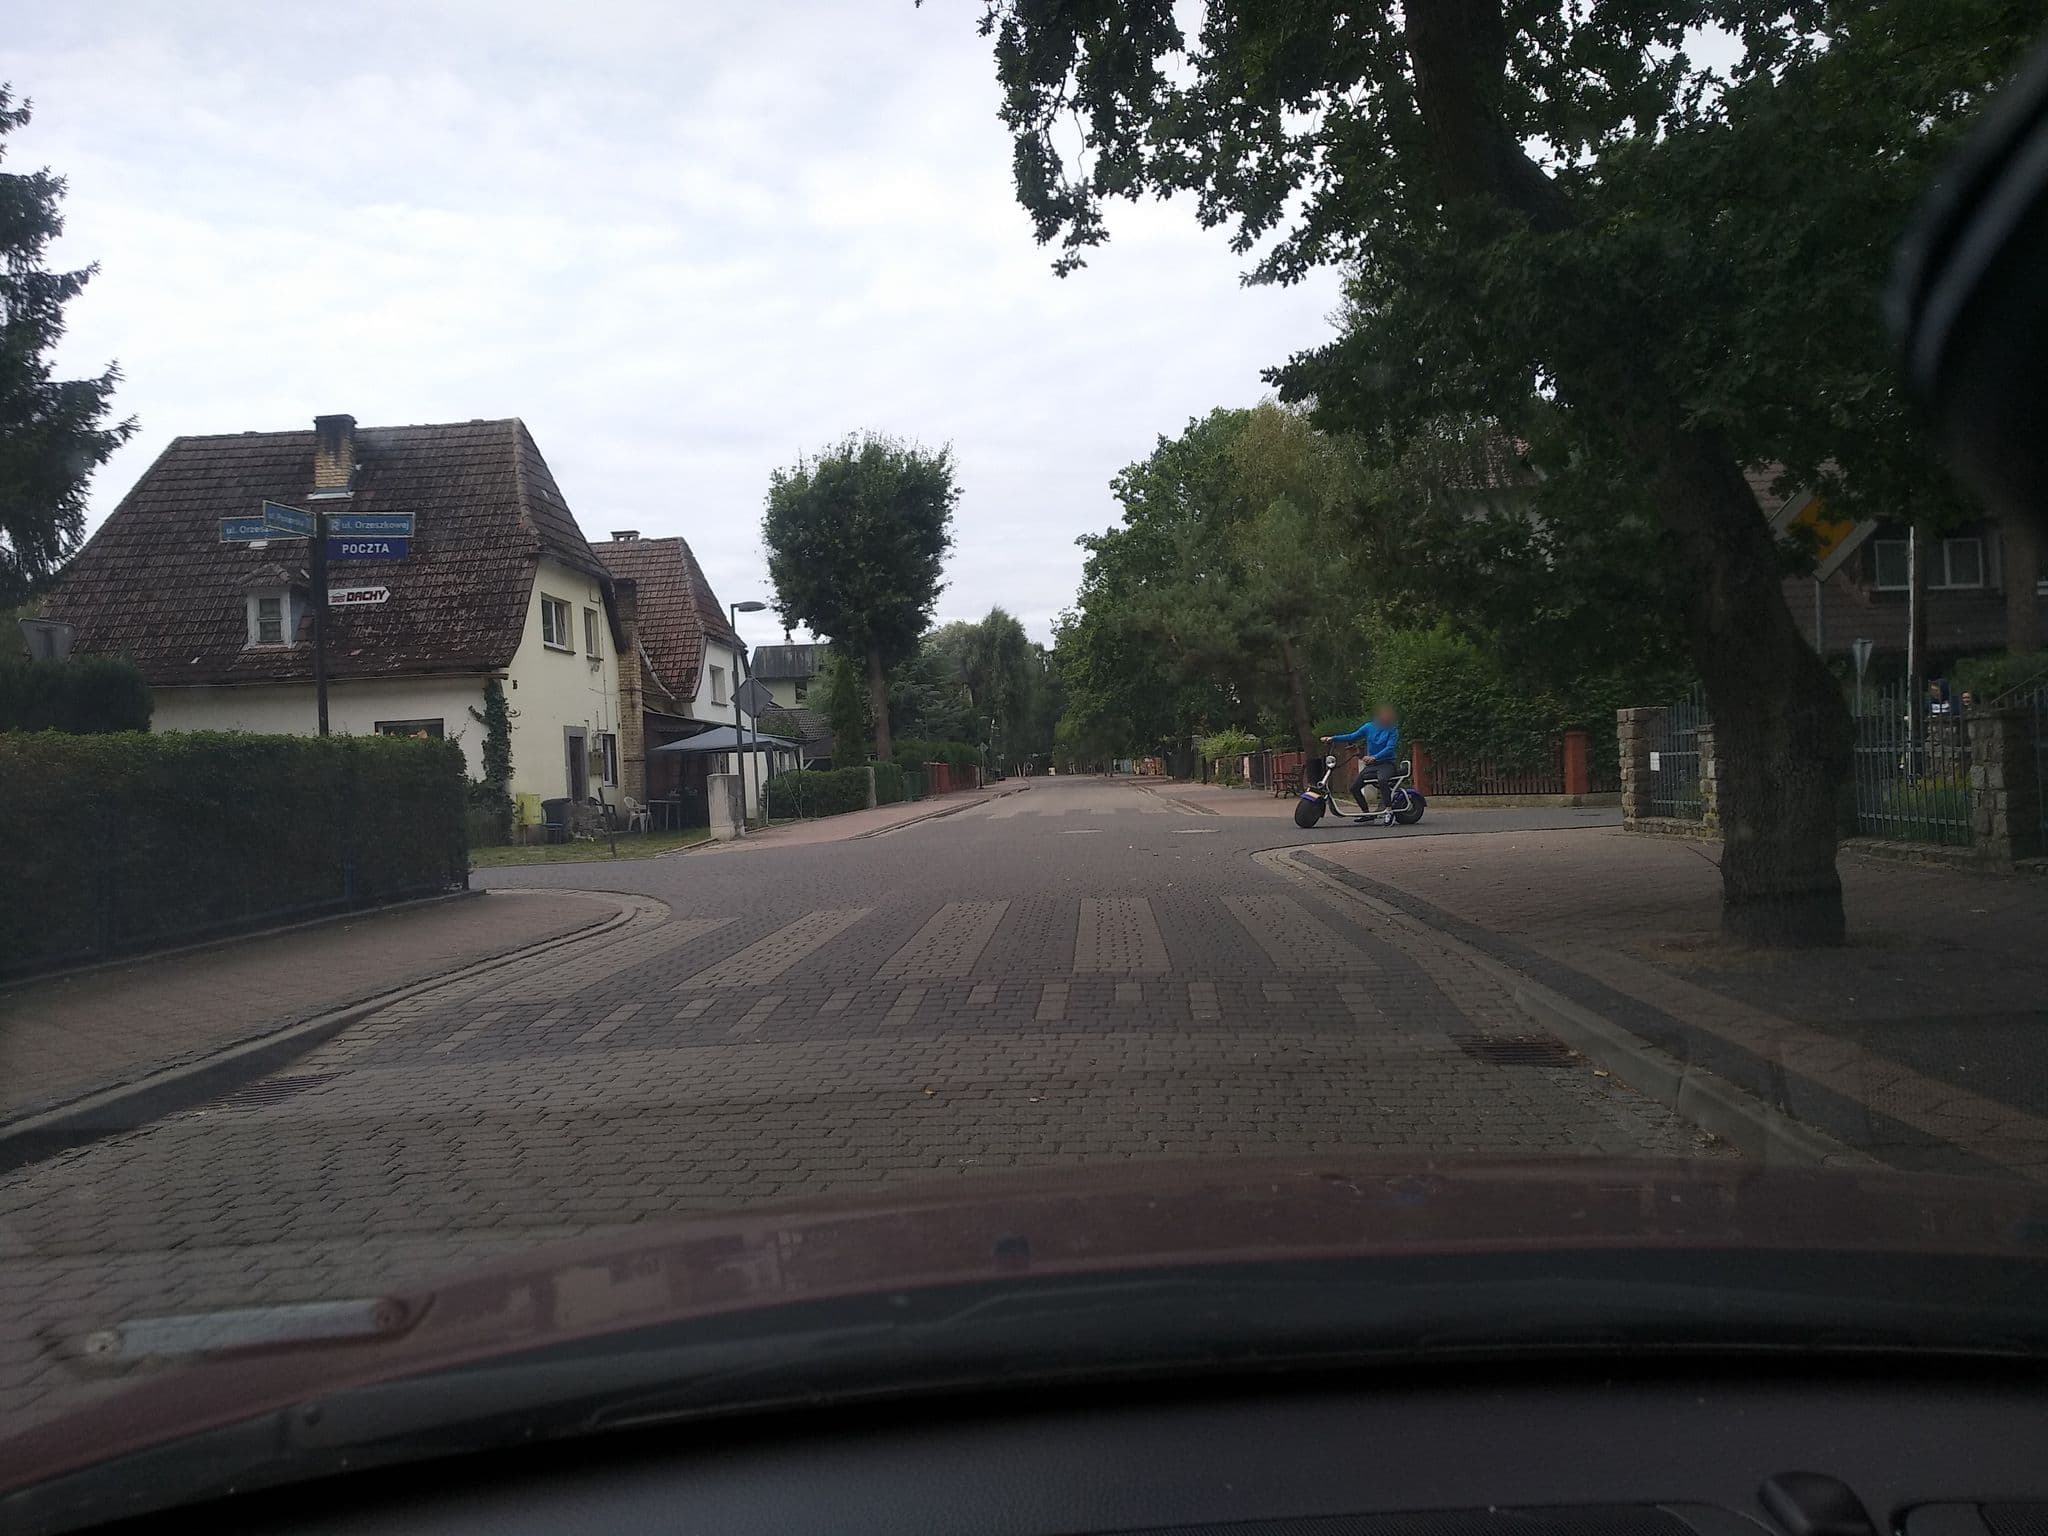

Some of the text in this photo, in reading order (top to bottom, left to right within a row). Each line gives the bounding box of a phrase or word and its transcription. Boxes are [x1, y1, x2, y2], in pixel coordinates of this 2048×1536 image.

[355, 520, 410, 531] Orzeszkowej
[341, 543, 390, 554] POCZTA
[346, 590, 387, 602] DACHY
